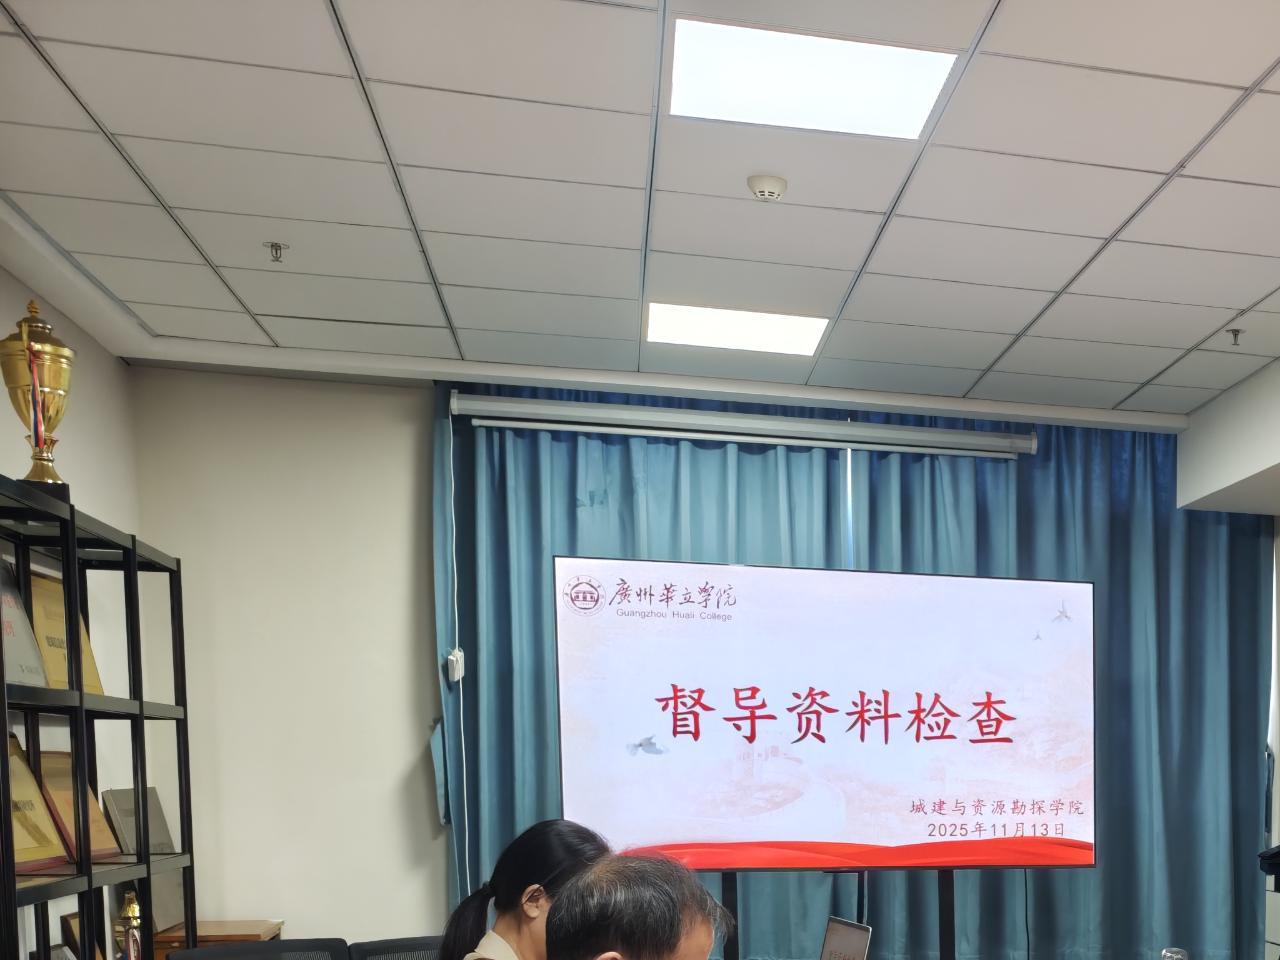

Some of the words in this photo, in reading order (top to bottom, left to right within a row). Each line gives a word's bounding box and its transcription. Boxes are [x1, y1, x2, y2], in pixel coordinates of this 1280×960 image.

[616, 608, 667, 619] Guangzhou
[672, 610, 695, 619] Huali
[699, 611, 732, 622] College
[655, 684, 1017, 746] 督导资料检查
[909, 798, 1084, 816] 城建与资源勘探学院
[927, 821, 1065, 838] 2025年11月13日
